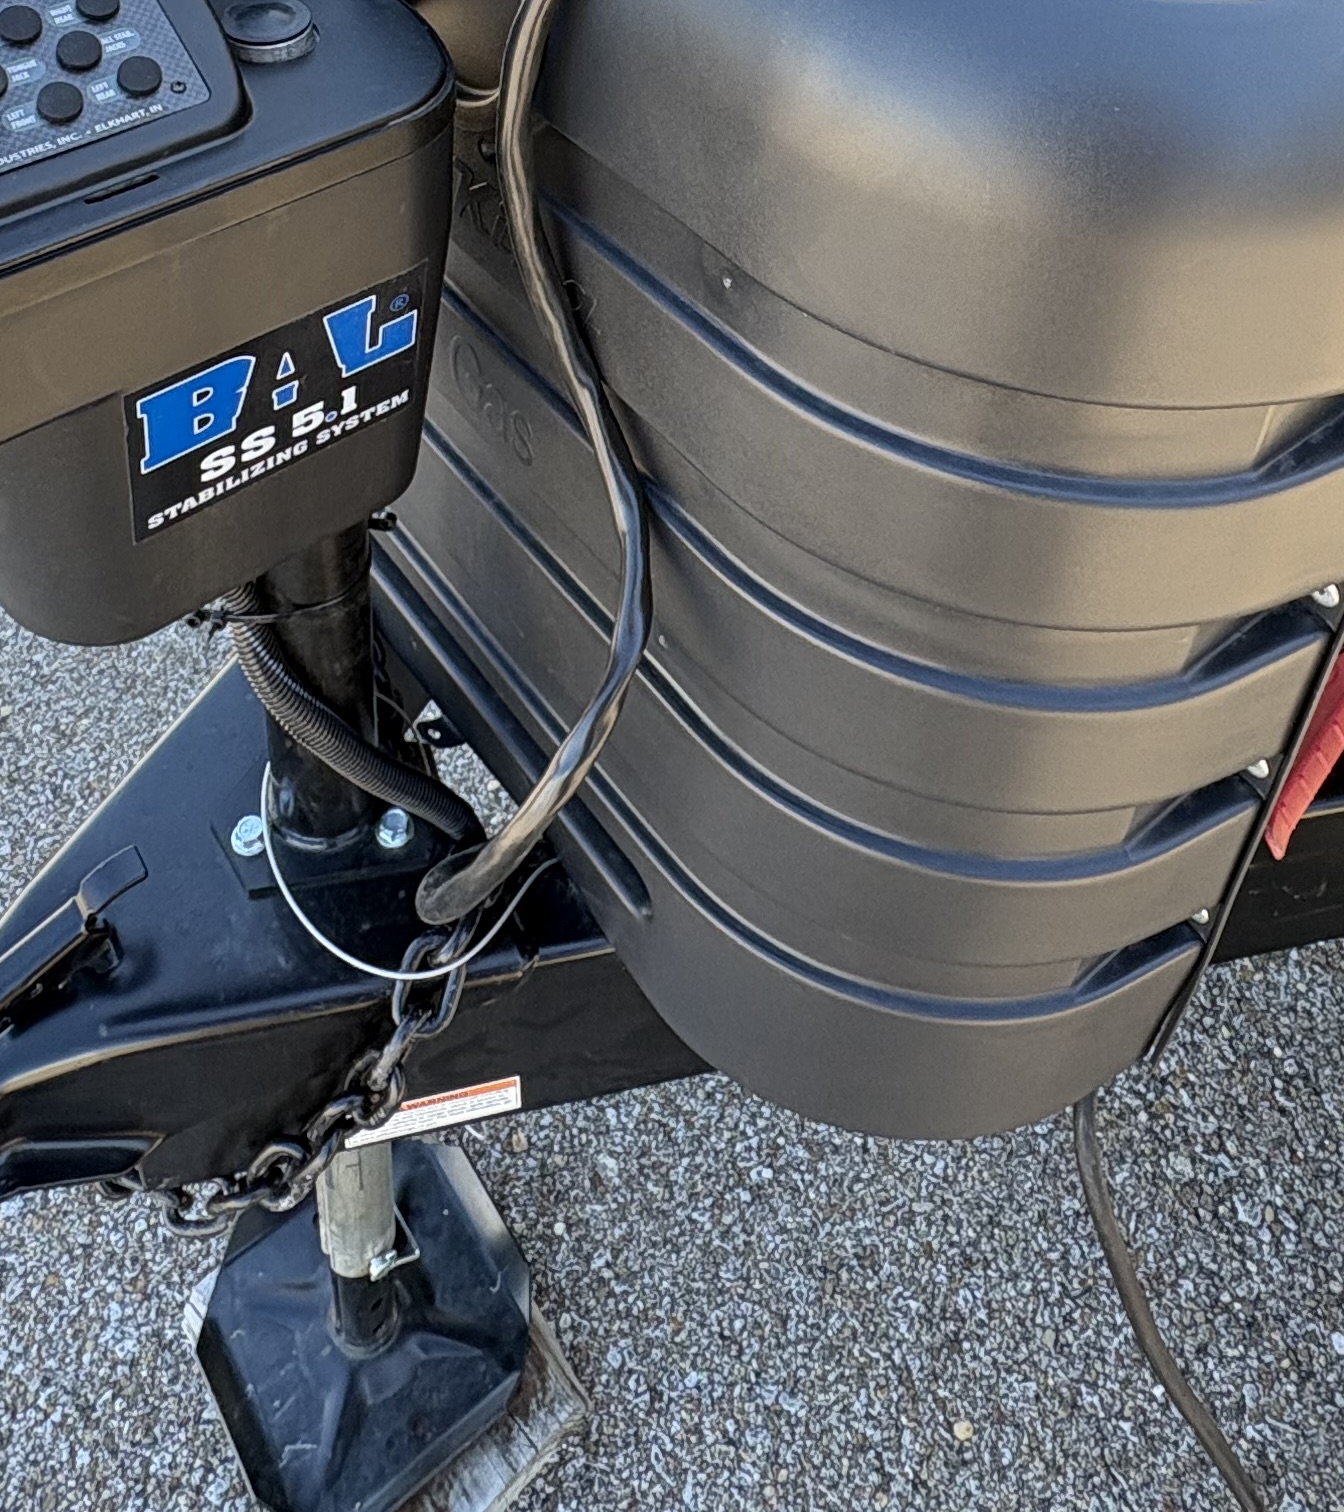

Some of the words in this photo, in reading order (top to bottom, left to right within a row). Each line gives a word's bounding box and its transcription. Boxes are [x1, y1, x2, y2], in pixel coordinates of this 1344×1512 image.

[11, 71, 30, 83] JACK
[91, 81, 109, 93] LEFT
[6, 109, 25, 121] LEFT
[10, 115, 37, 130] FRONT
[57, 132, 83, 146] INC.
[94, 109, 149, 133] ELKHART,
[149, 103, 163, 115] IN
[136, 294, 418, 475] BAL
[200, 425, 276, 483] SS
[292, 386, 357, 438] 5.1
[147, 441, 309, 530] STABILIZING
[316, 389, 410, 446] SYSTEM
